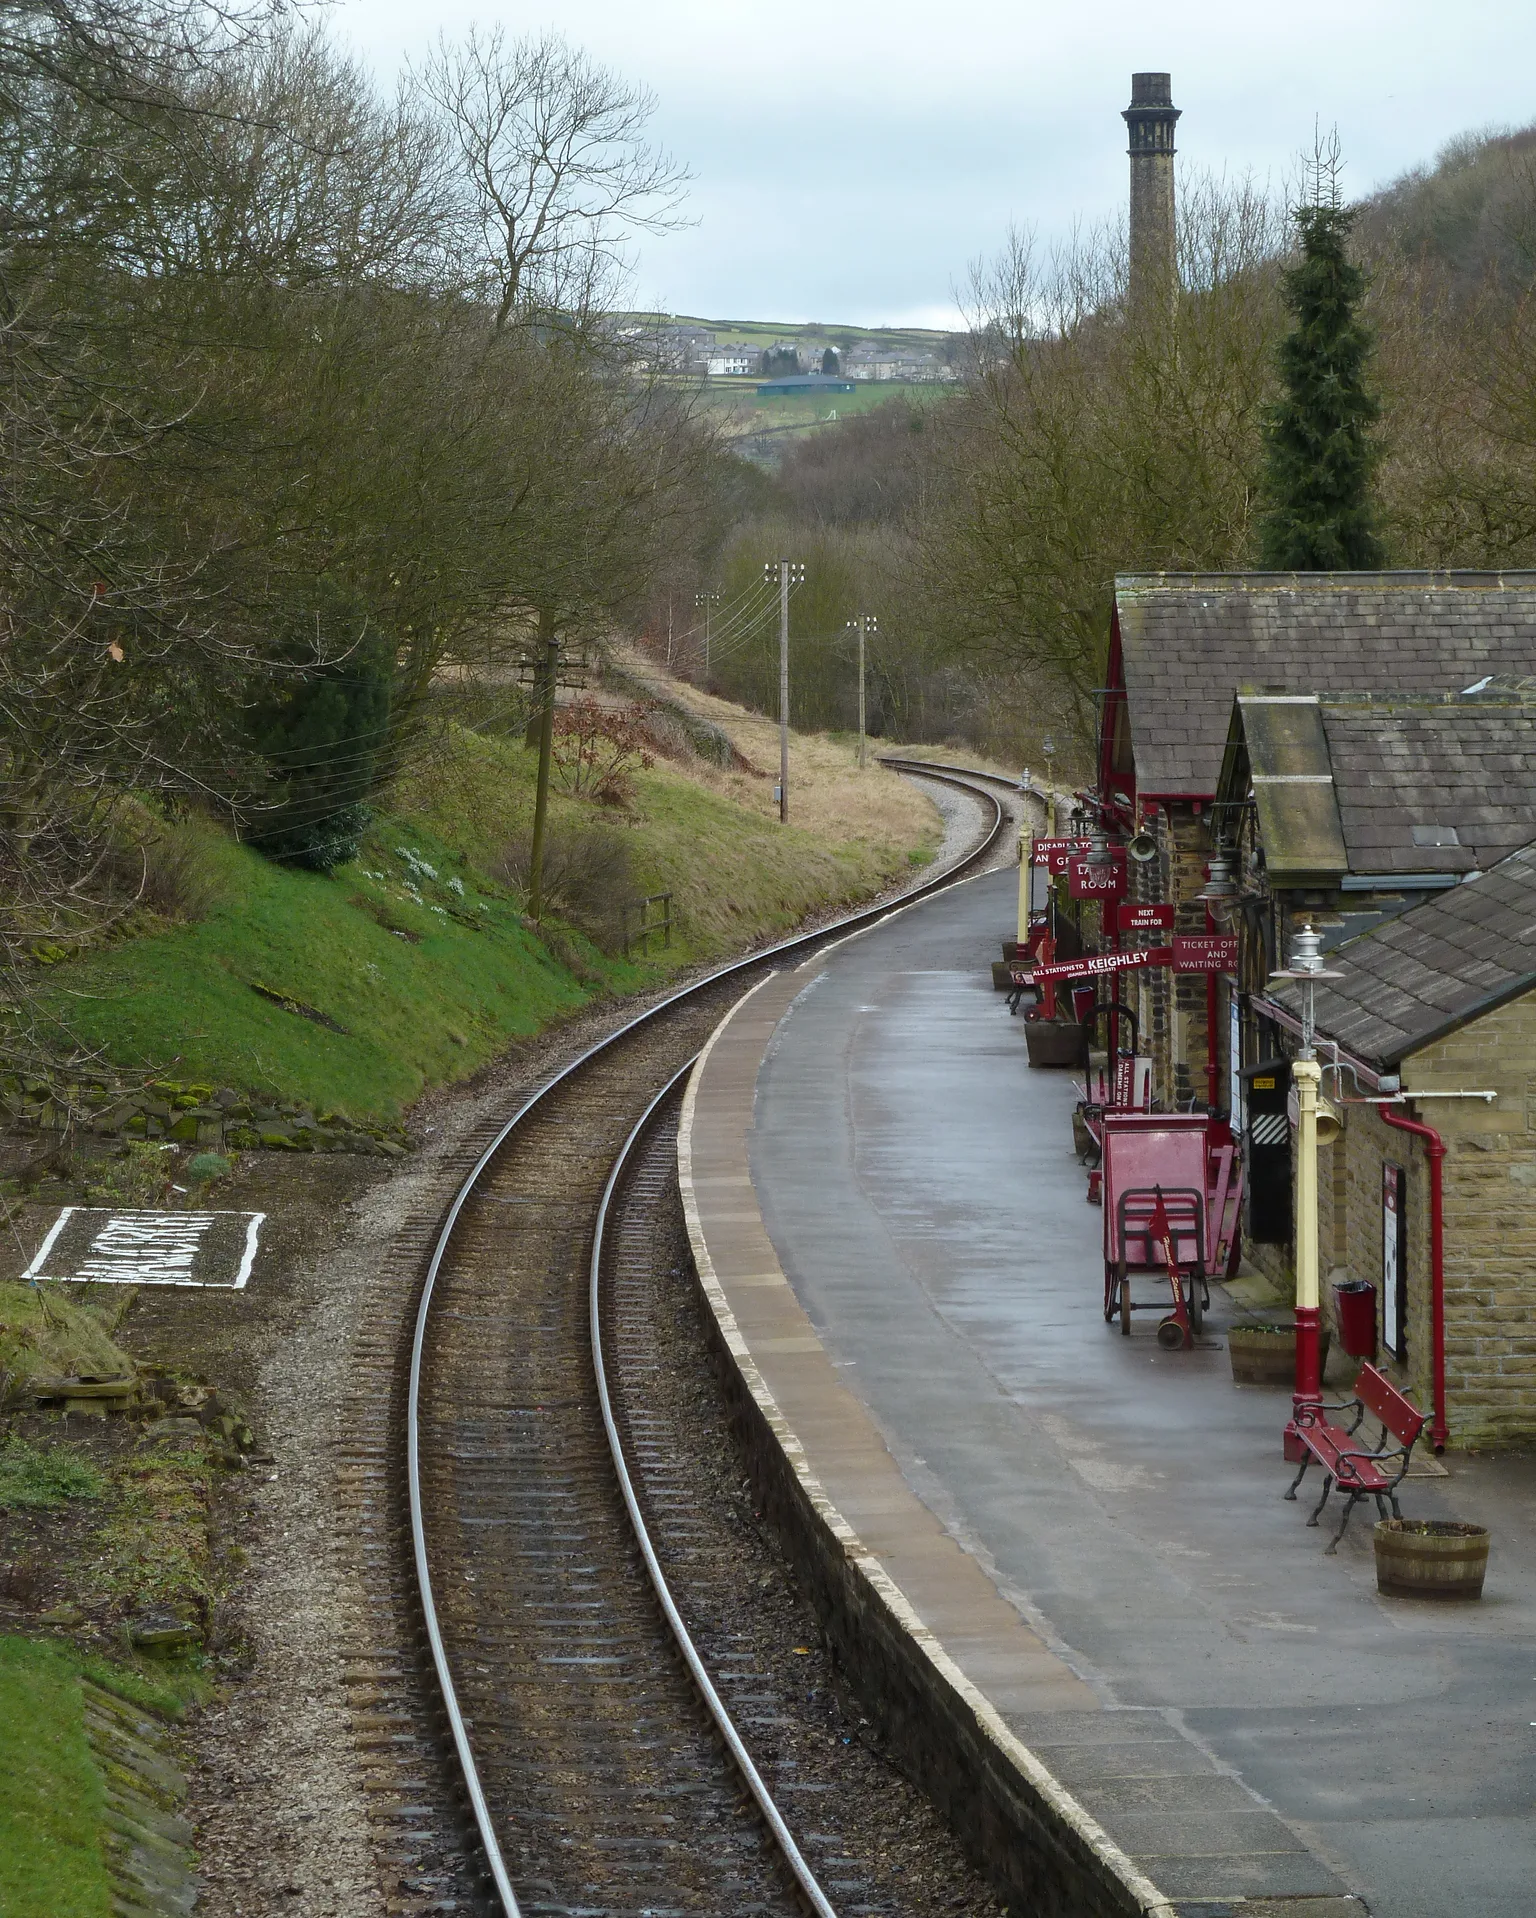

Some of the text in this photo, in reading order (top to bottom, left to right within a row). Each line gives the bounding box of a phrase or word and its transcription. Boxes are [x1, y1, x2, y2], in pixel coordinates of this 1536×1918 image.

[1138, 909, 1154, 917] NEXT
[1150, 918, 1162, 926] FOR
[1181, 940, 1215, 949] TICKET
[1207, 950, 1228, 959] AND
[1045, 965, 1076, 975] STATIONS
[1087, 952, 1149, 970] KEIGHLEY
[1179, 960, 1221, 969] WAITING
[76, 1217, 215, 1282] HAWORTH
